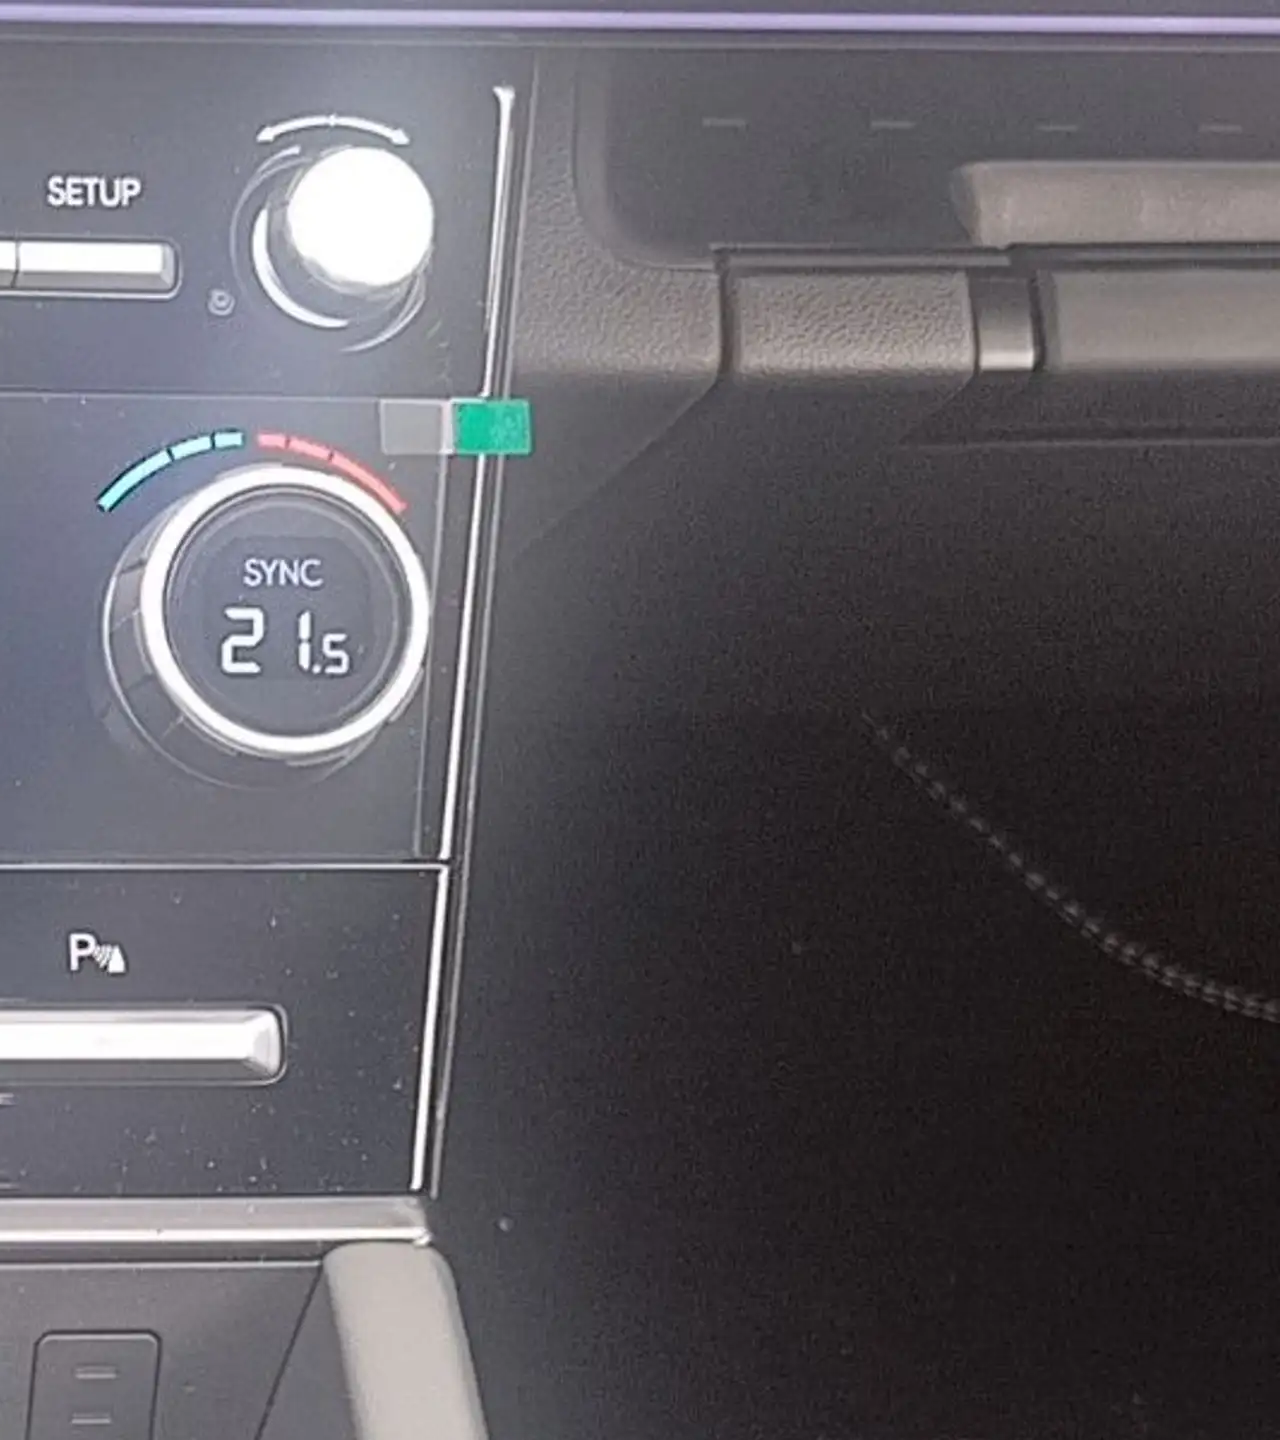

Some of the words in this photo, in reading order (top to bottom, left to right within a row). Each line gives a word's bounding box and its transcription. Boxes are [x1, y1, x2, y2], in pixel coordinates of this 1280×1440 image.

[46, 175, 141, 207] SETUP
[243, 558, 324, 588] SYNC
[220, 606, 351, 675] 21.5
